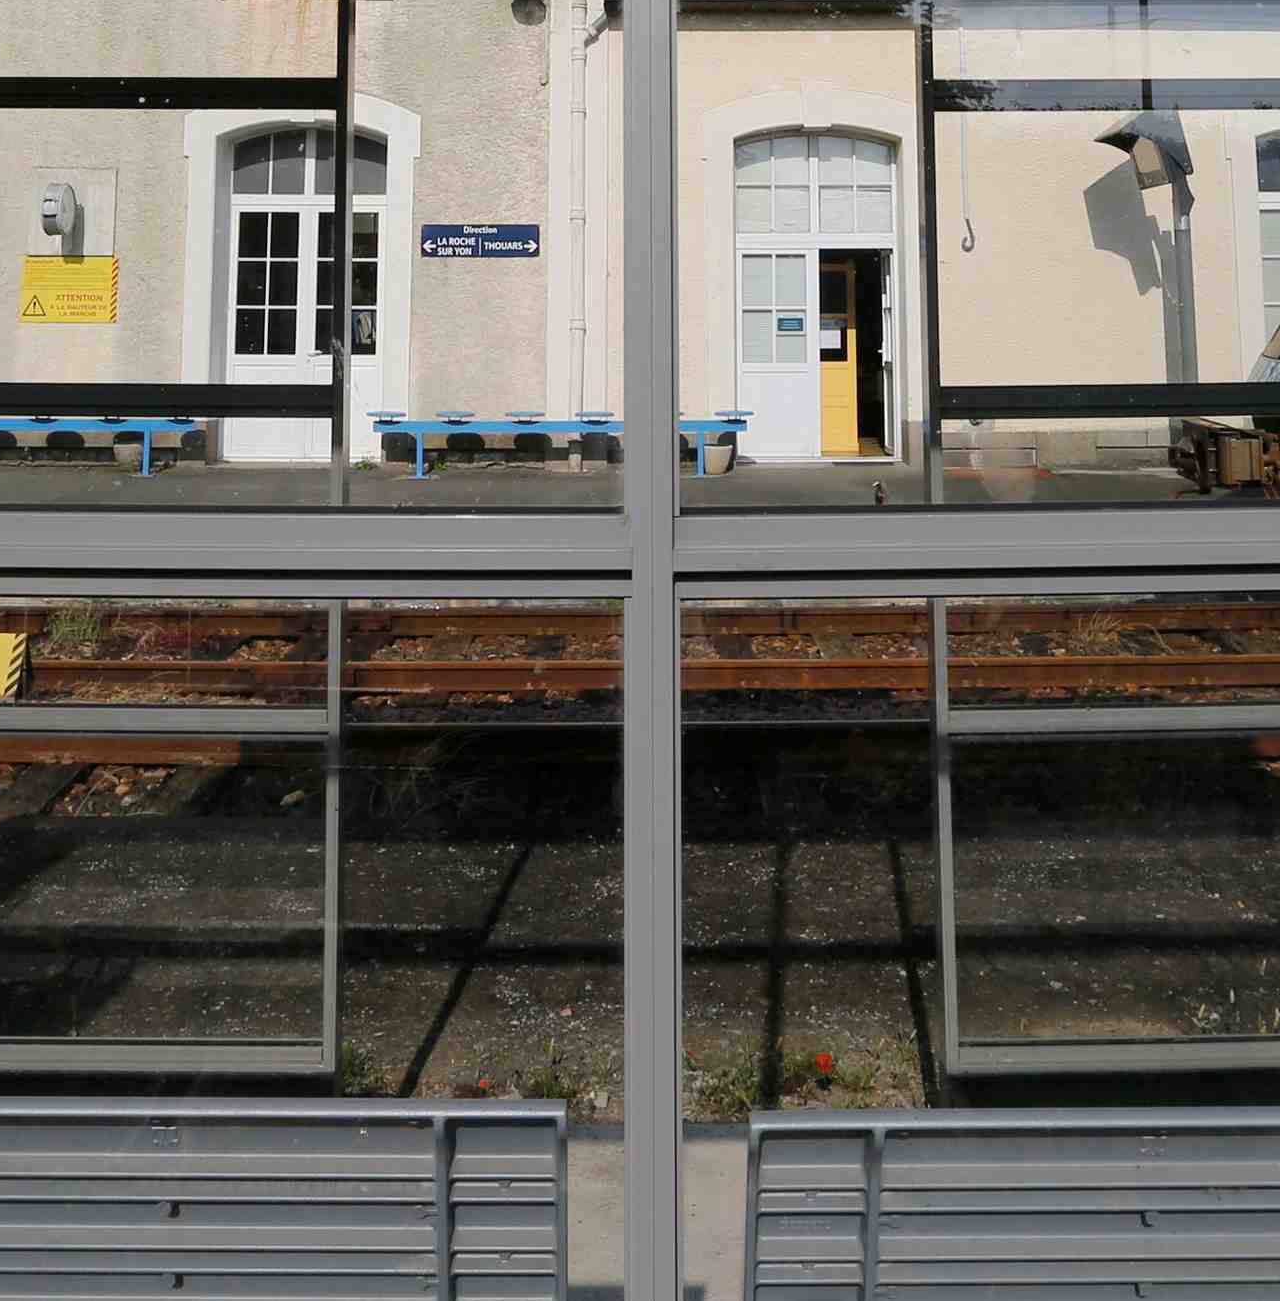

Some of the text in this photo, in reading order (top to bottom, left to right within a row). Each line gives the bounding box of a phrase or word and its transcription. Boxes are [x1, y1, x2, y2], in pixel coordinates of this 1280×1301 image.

[463, 226, 497, 234] Direction
[437, 237, 476, 245] LA ROCHE
[483, 241, 523, 250] THOUARS
[437, 247, 472, 256] SUR YON
